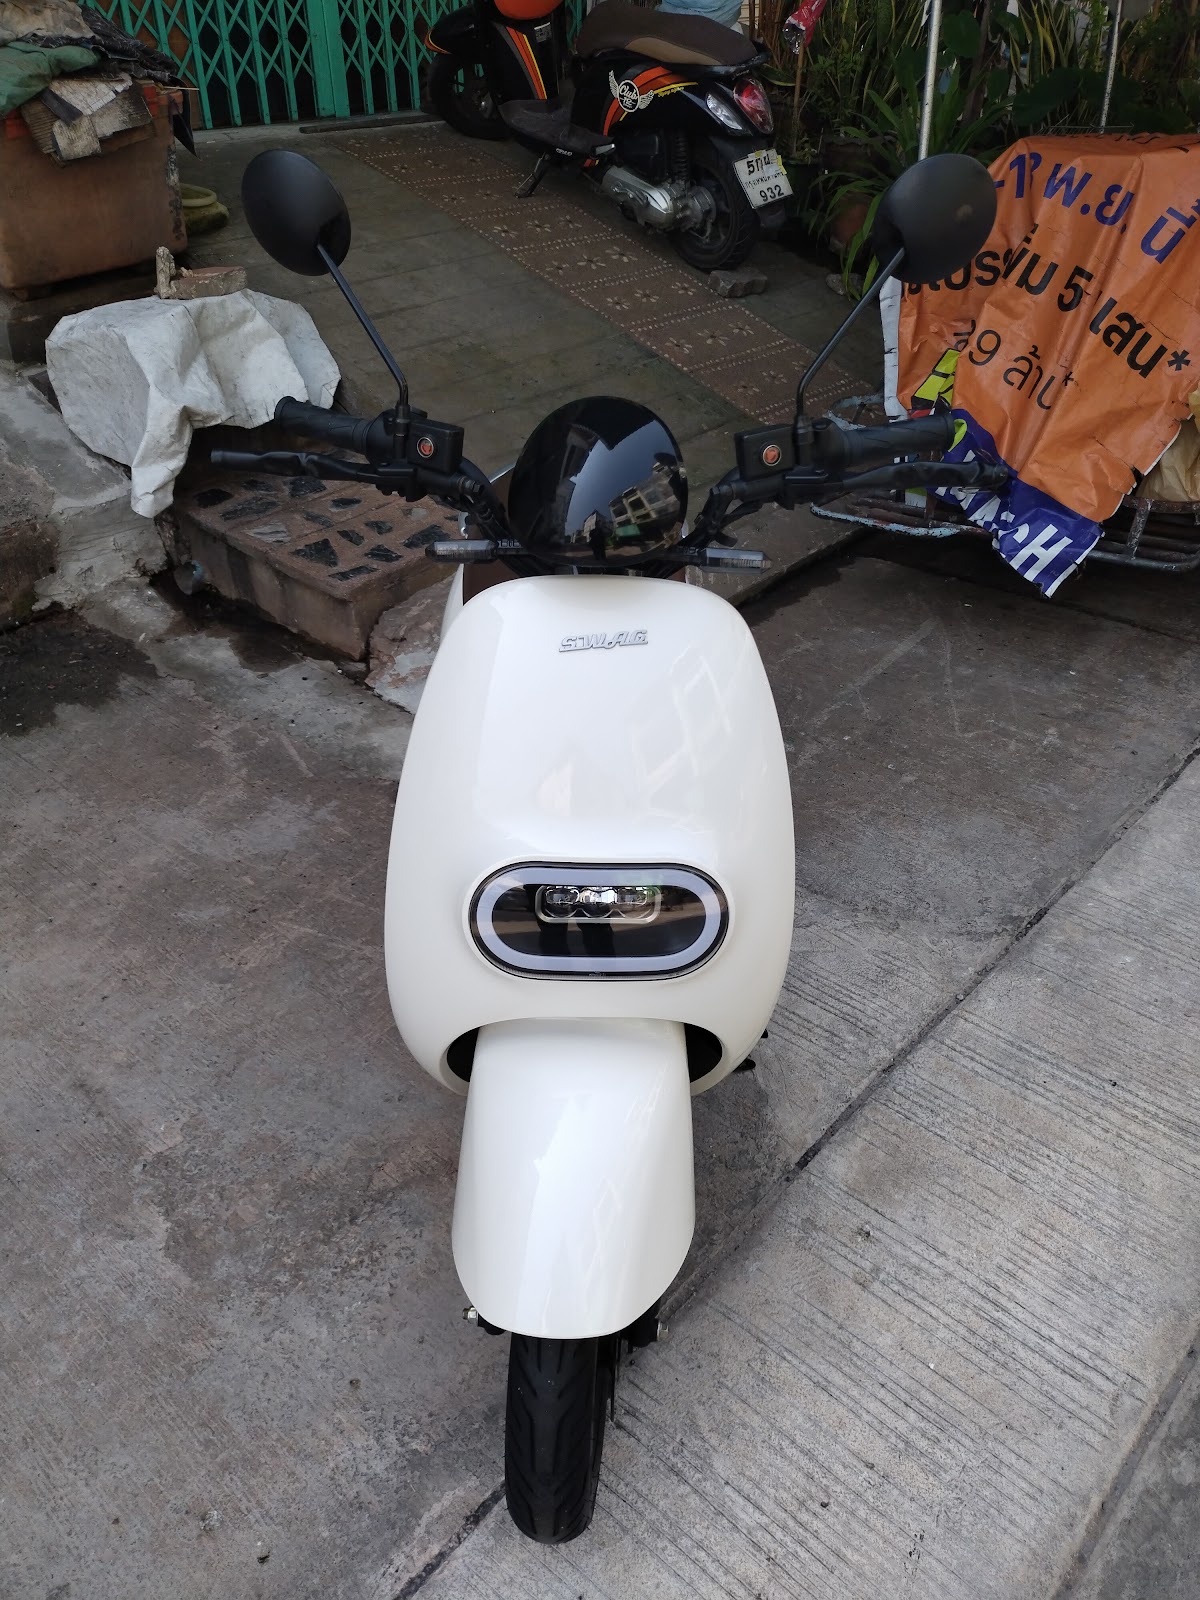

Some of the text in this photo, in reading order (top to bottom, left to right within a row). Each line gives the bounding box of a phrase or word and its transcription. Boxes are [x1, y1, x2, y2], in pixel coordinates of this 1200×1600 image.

[620, 84, 639, 100] Club
[759, 184, 785, 202] 932
[1044, 163, 1135, 234] พ.ย.
[1058, 265, 1093, 312] 5
[559, 629, 648, 653] SWAG
